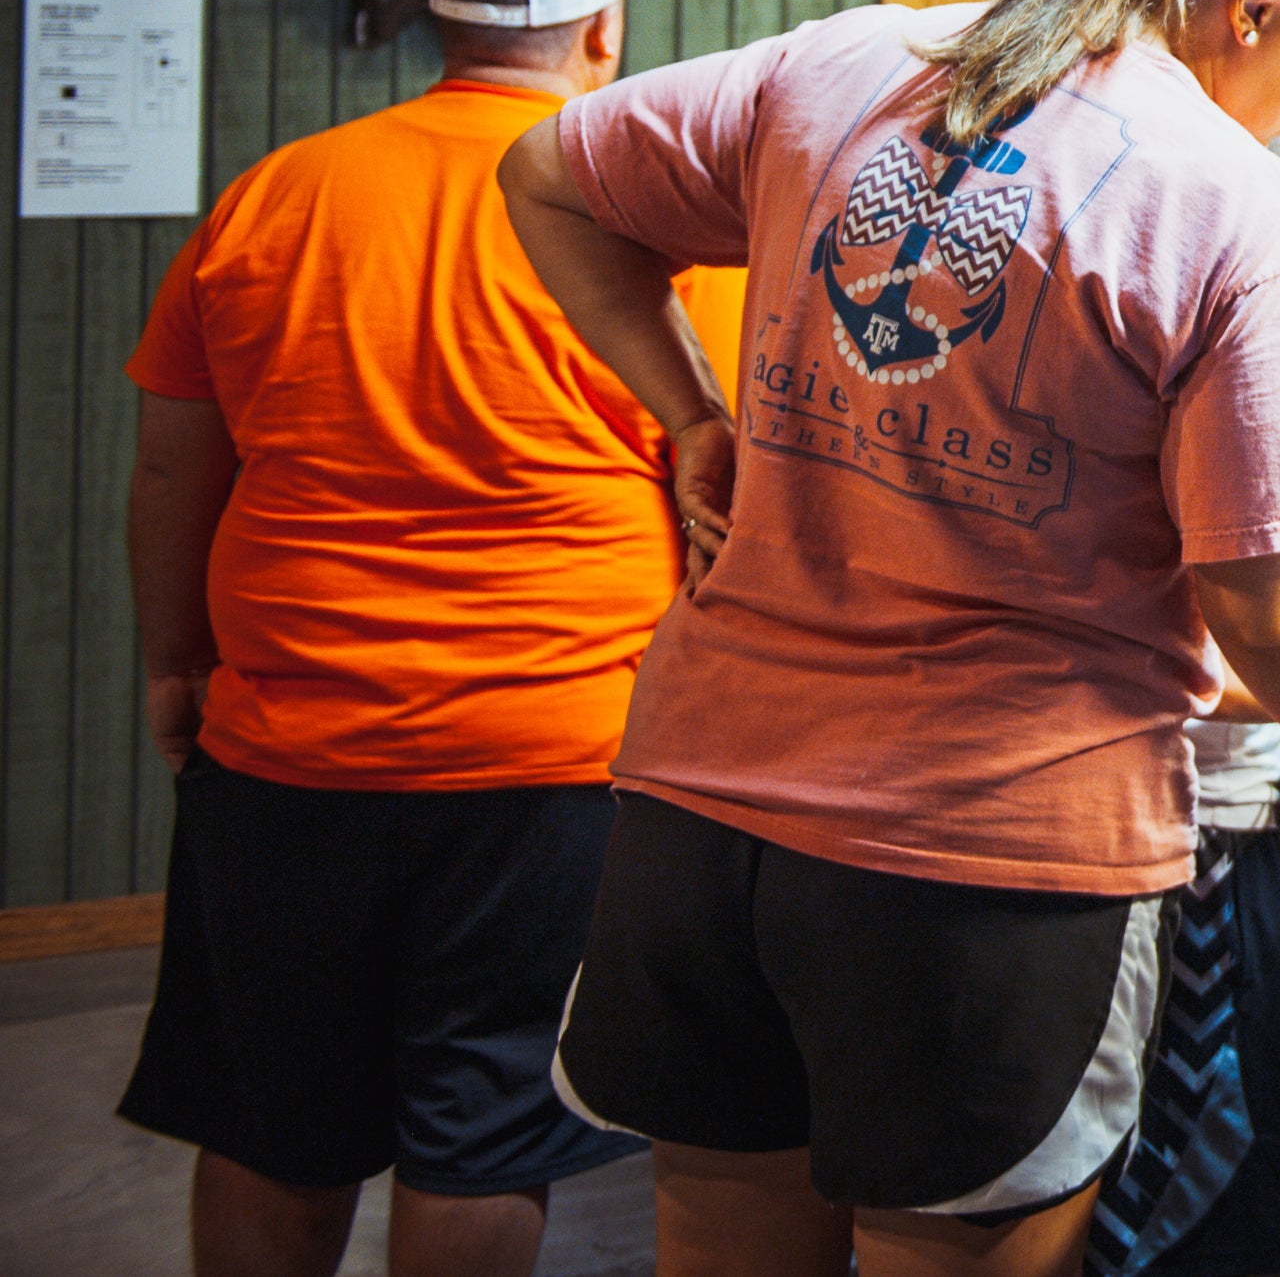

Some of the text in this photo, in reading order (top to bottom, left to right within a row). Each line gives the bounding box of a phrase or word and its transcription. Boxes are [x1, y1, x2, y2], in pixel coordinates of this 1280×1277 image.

[753, 417, 1029, 516] THERN STYLE
[877, 403, 1053, 476] class
